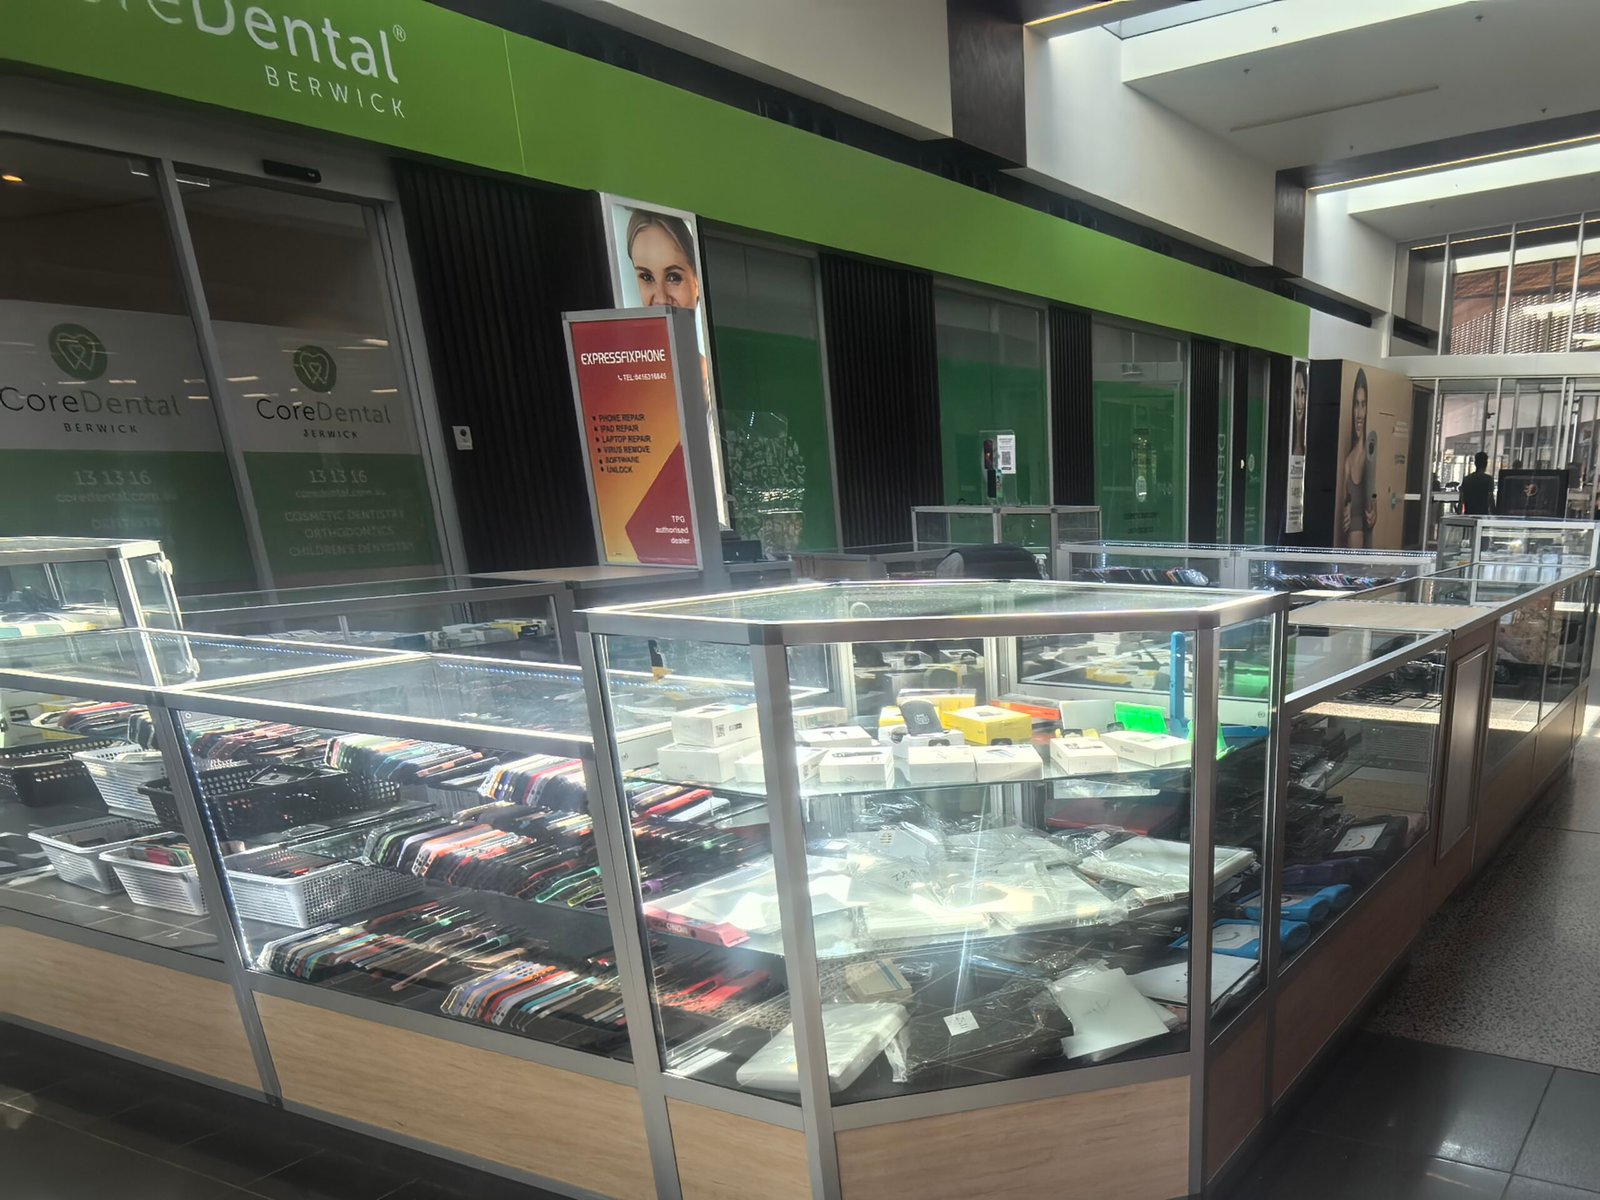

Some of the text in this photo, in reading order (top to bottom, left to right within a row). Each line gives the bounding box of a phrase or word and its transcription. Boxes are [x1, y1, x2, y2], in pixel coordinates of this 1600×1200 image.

[264, 65, 406, 118] BERWICK
[580, 349, 666, 365] EXPRESSFIXPHONE
[0, 387, 181, 417] CoreDental
[256, 398, 391, 423] CoreDental
[599, 413, 621, 422] PHONE
[63, 423, 138, 434] BERWICK
[616, 424, 639, 432] REPAIR
[602, 434, 652, 443] LAPTOP REPAIR
[603, 445, 651, 454] VIRUS REMOVE
[605, 456, 640, 464] SOFTWARE
[309, 469, 368, 484] 13 13 16
[284, 510, 345, 523] COSMETIC
[304, 525, 396, 539] ORTHODONTICS
